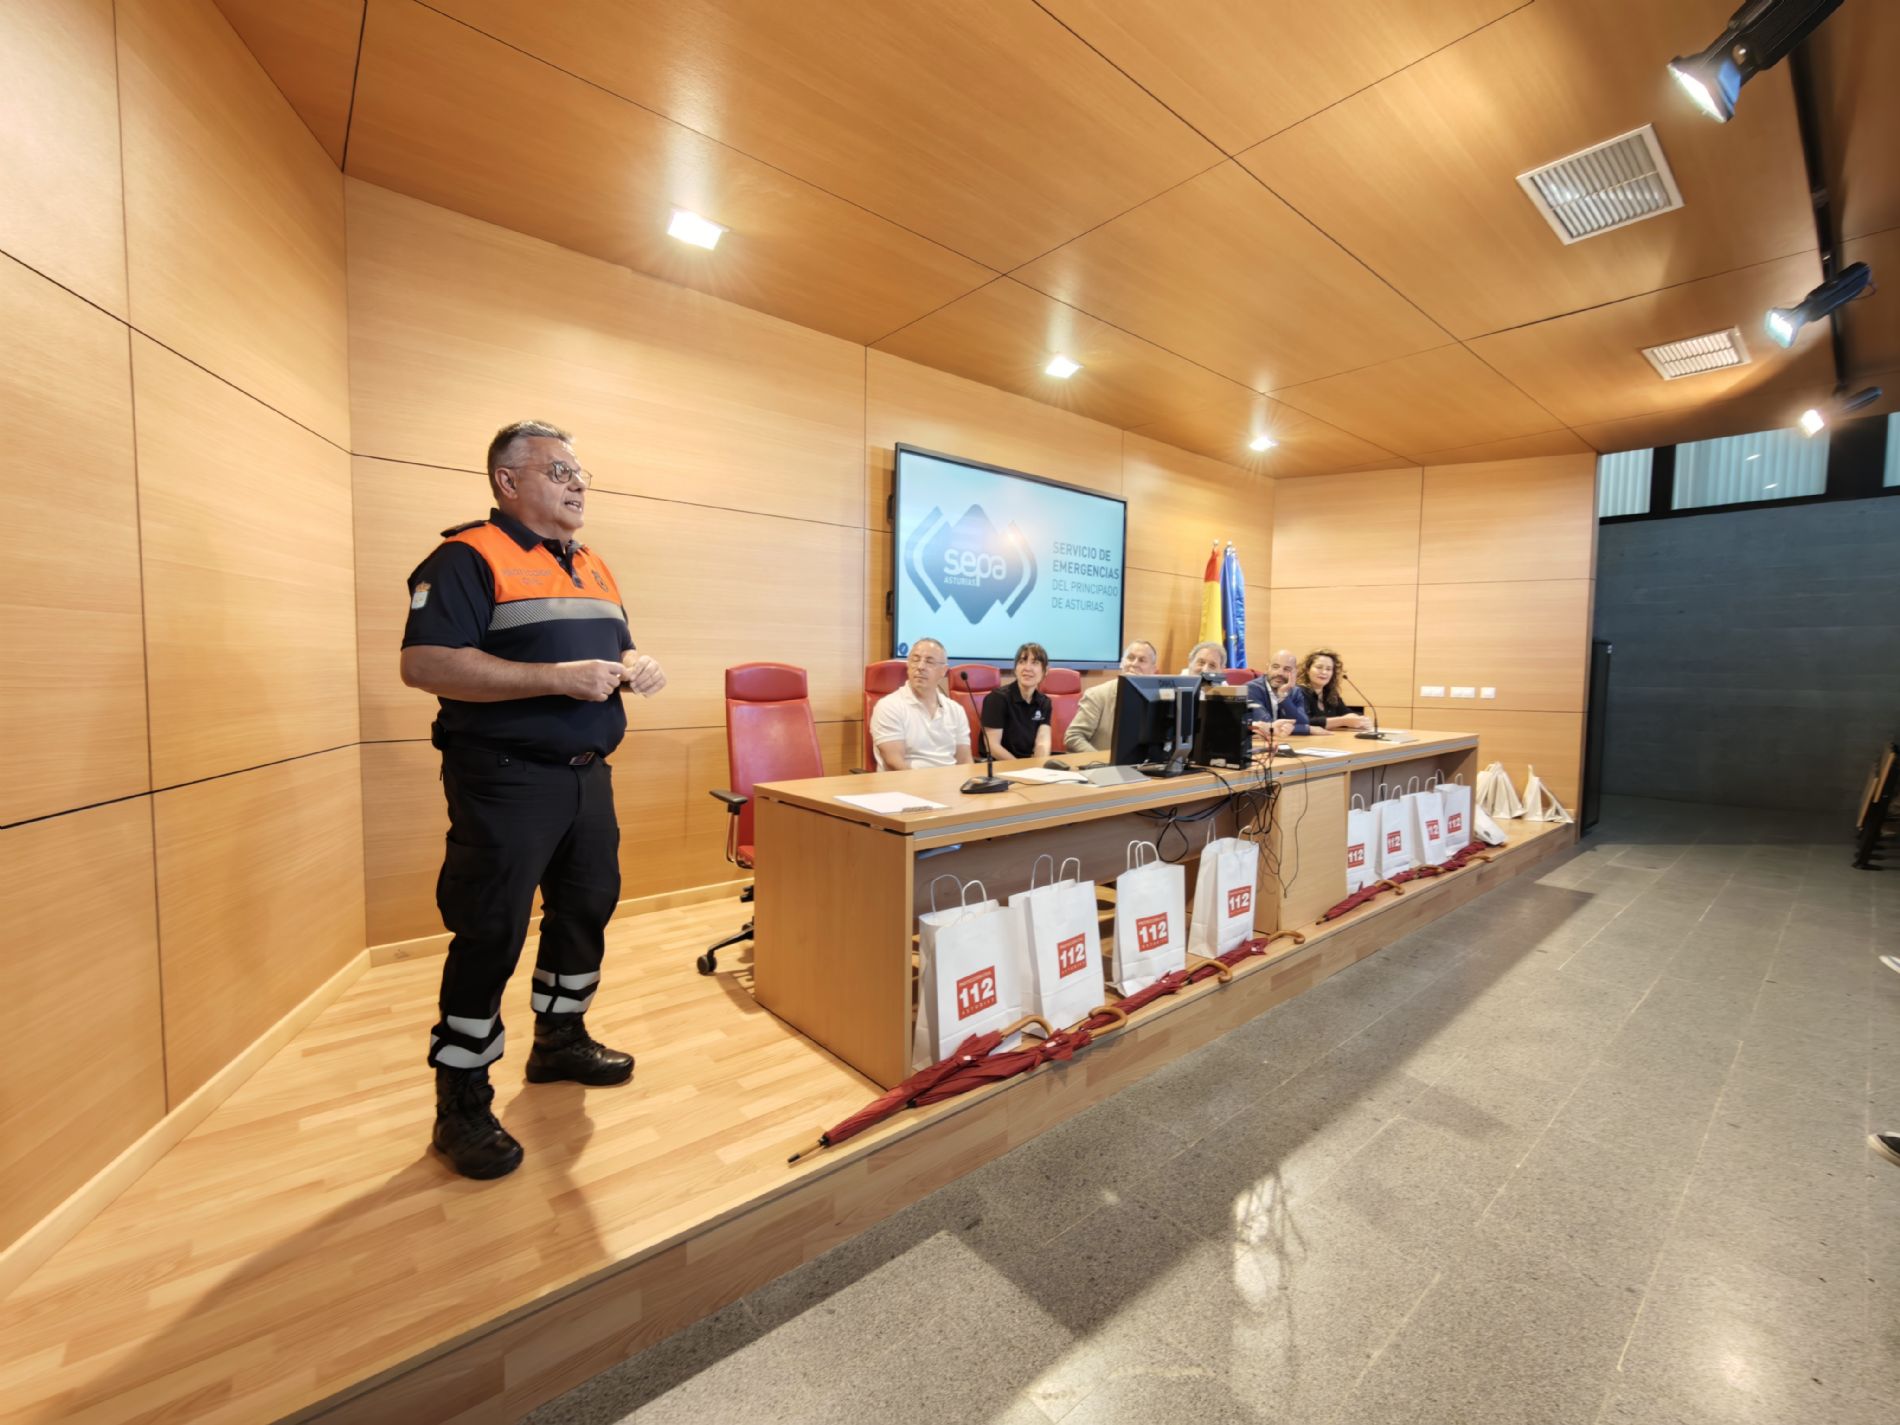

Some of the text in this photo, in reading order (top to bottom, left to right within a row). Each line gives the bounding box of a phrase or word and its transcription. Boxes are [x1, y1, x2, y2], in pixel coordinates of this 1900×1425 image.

[1052, 541, 1112, 562] SERVICIO DE
[943, 548, 1007, 588] sepa
[1052, 559, 1120, 580] EMERGENCIAS
[1052, 578, 1119, 598] DEL PRINCIPADO
[1051, 596, 1105, 612] DE ASTURIAS
[1348, 848, 1364, 863] 112
[1229, 892, 1250, 911] 112
[1139, 920, 1167, 944] 112
[1060, 943, 1085, 969] 112
[959, 977, 995, 1009] 112
